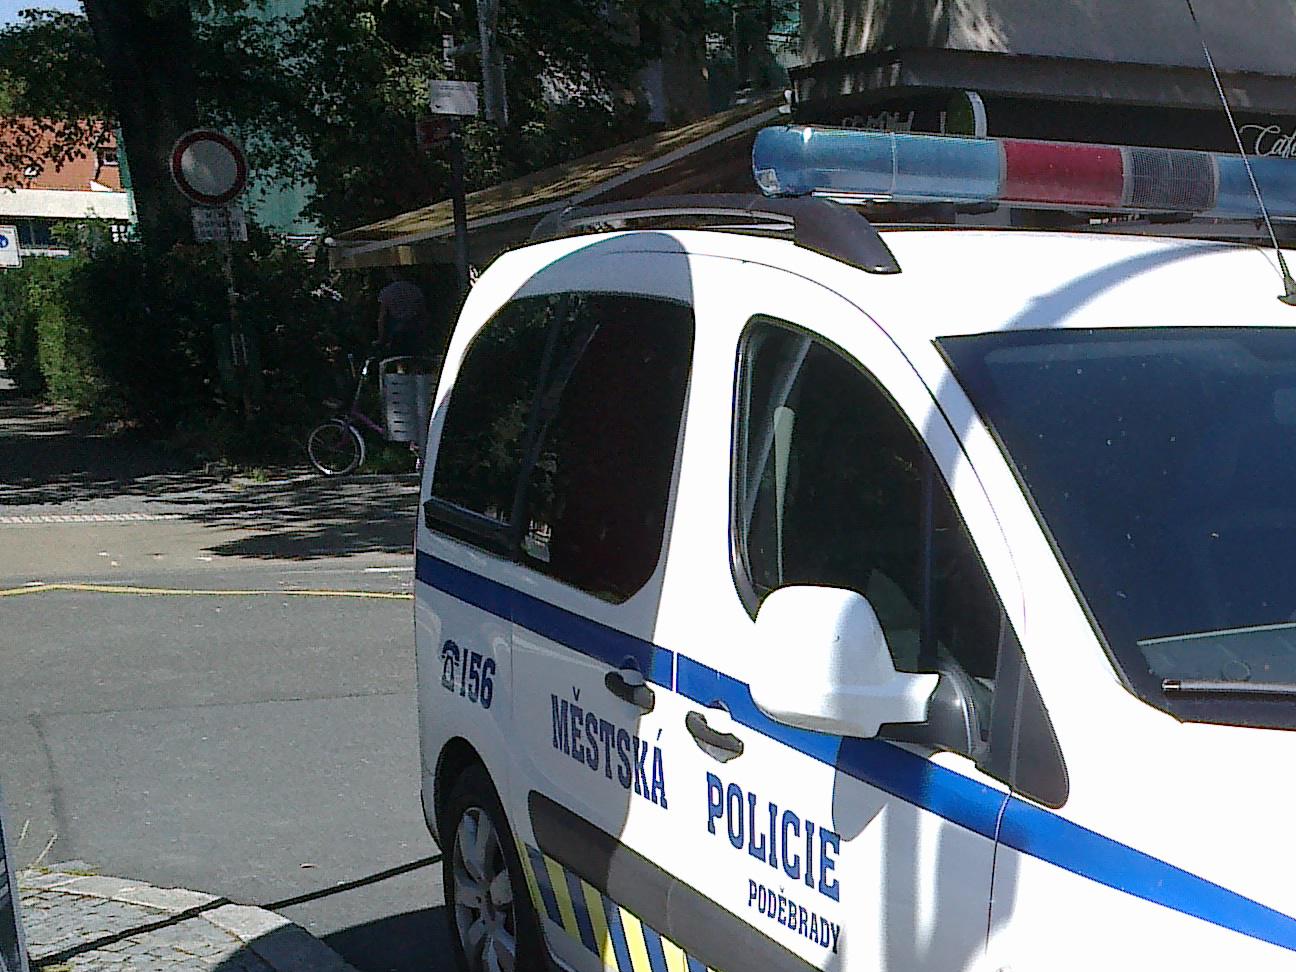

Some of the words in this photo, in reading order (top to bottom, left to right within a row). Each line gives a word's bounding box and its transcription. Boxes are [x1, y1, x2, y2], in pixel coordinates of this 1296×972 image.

[459, 648, 496, 710] 156
[550, 686, 669, 811] MĚSTSKÁ
[706, 771, 842, 903] POLICIE
[748, 878, 842, 955] PODĚBRADY
